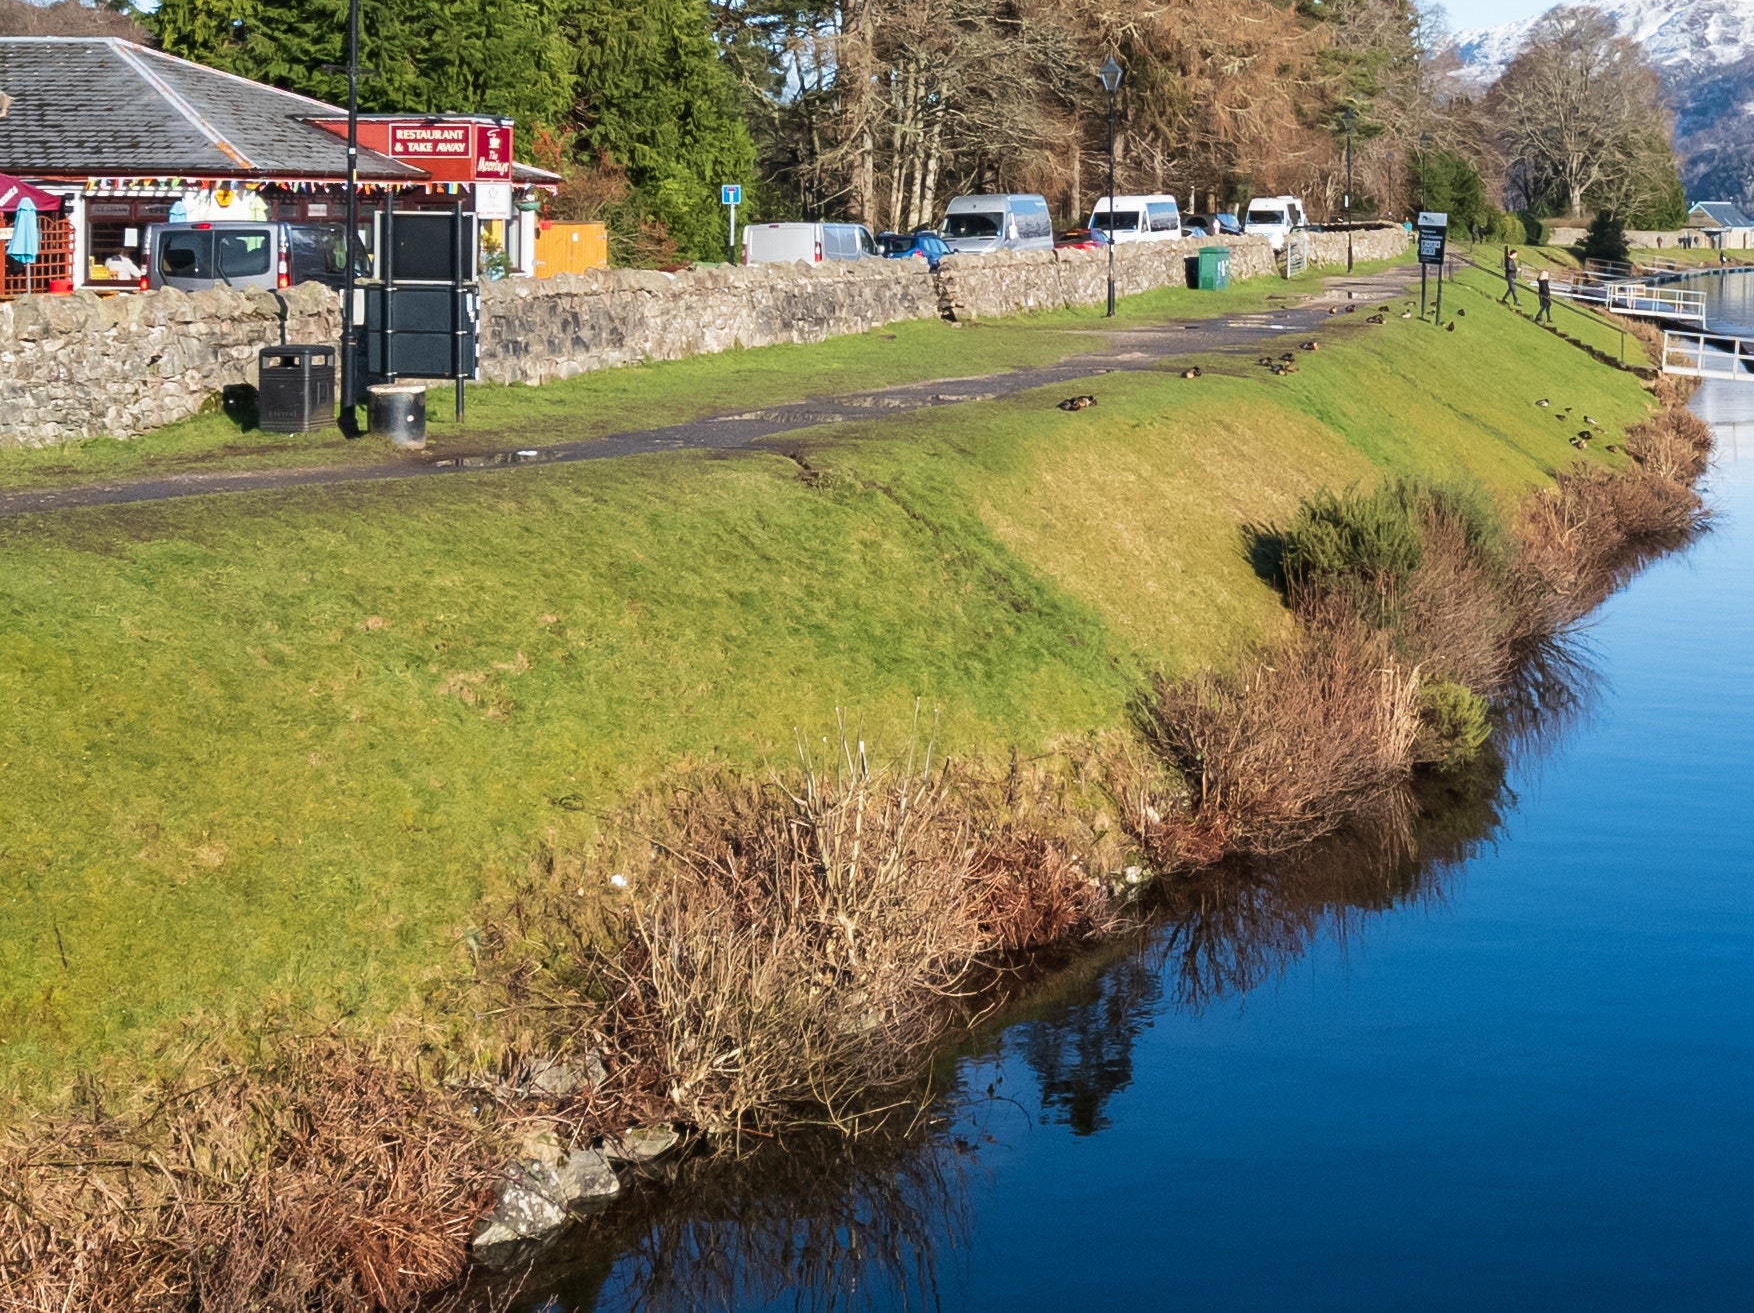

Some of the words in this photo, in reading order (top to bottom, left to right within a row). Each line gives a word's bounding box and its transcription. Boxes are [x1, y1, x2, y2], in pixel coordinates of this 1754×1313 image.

[396, 129, 464, 140] RESTAURANT
[394, 143, 404, 152] &
[407, 142, 433, 152] TAKE
[436, 142, 466, 152] AWAY
